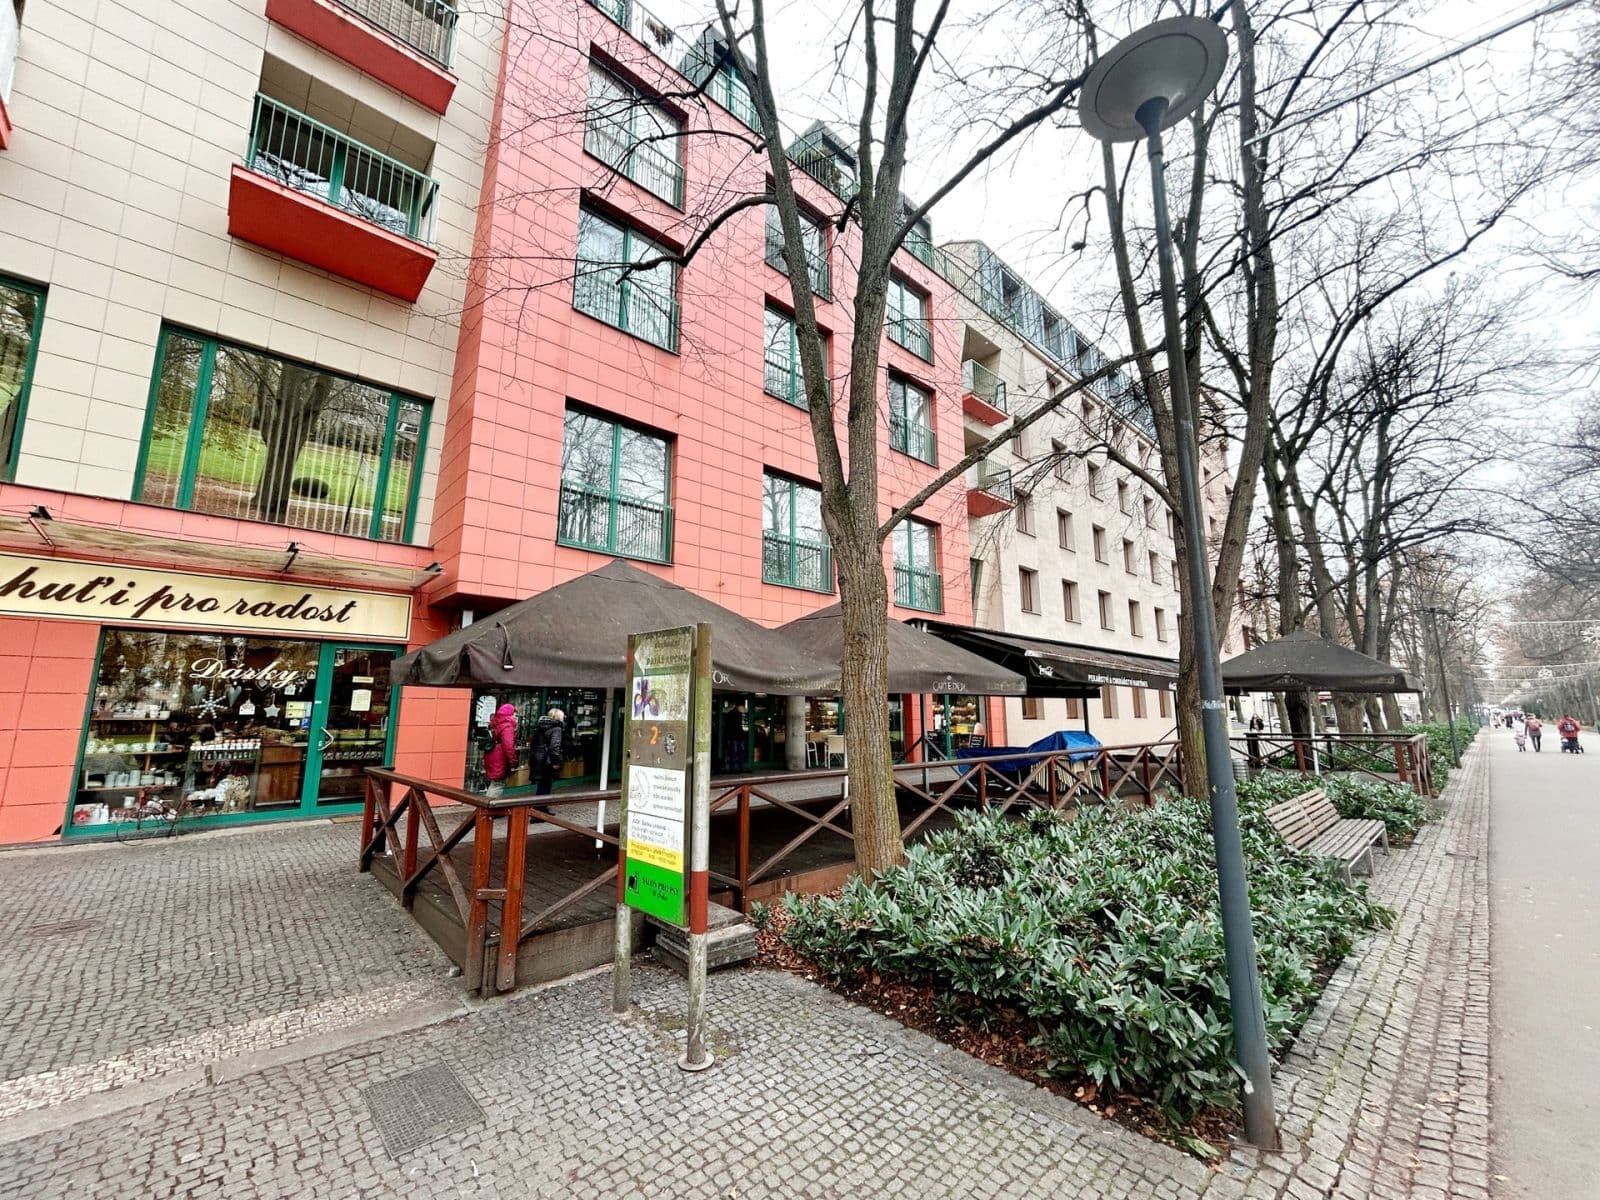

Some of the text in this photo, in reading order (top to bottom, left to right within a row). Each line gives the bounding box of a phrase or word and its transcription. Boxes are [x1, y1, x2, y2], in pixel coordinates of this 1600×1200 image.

[100, 581, 136, 606] i
[131, 585, 220, 618] pro
[224, 593, 357, 623] radost
[189, 657, 299, 689] Dárky
[712, 670, 736, 687] OR
